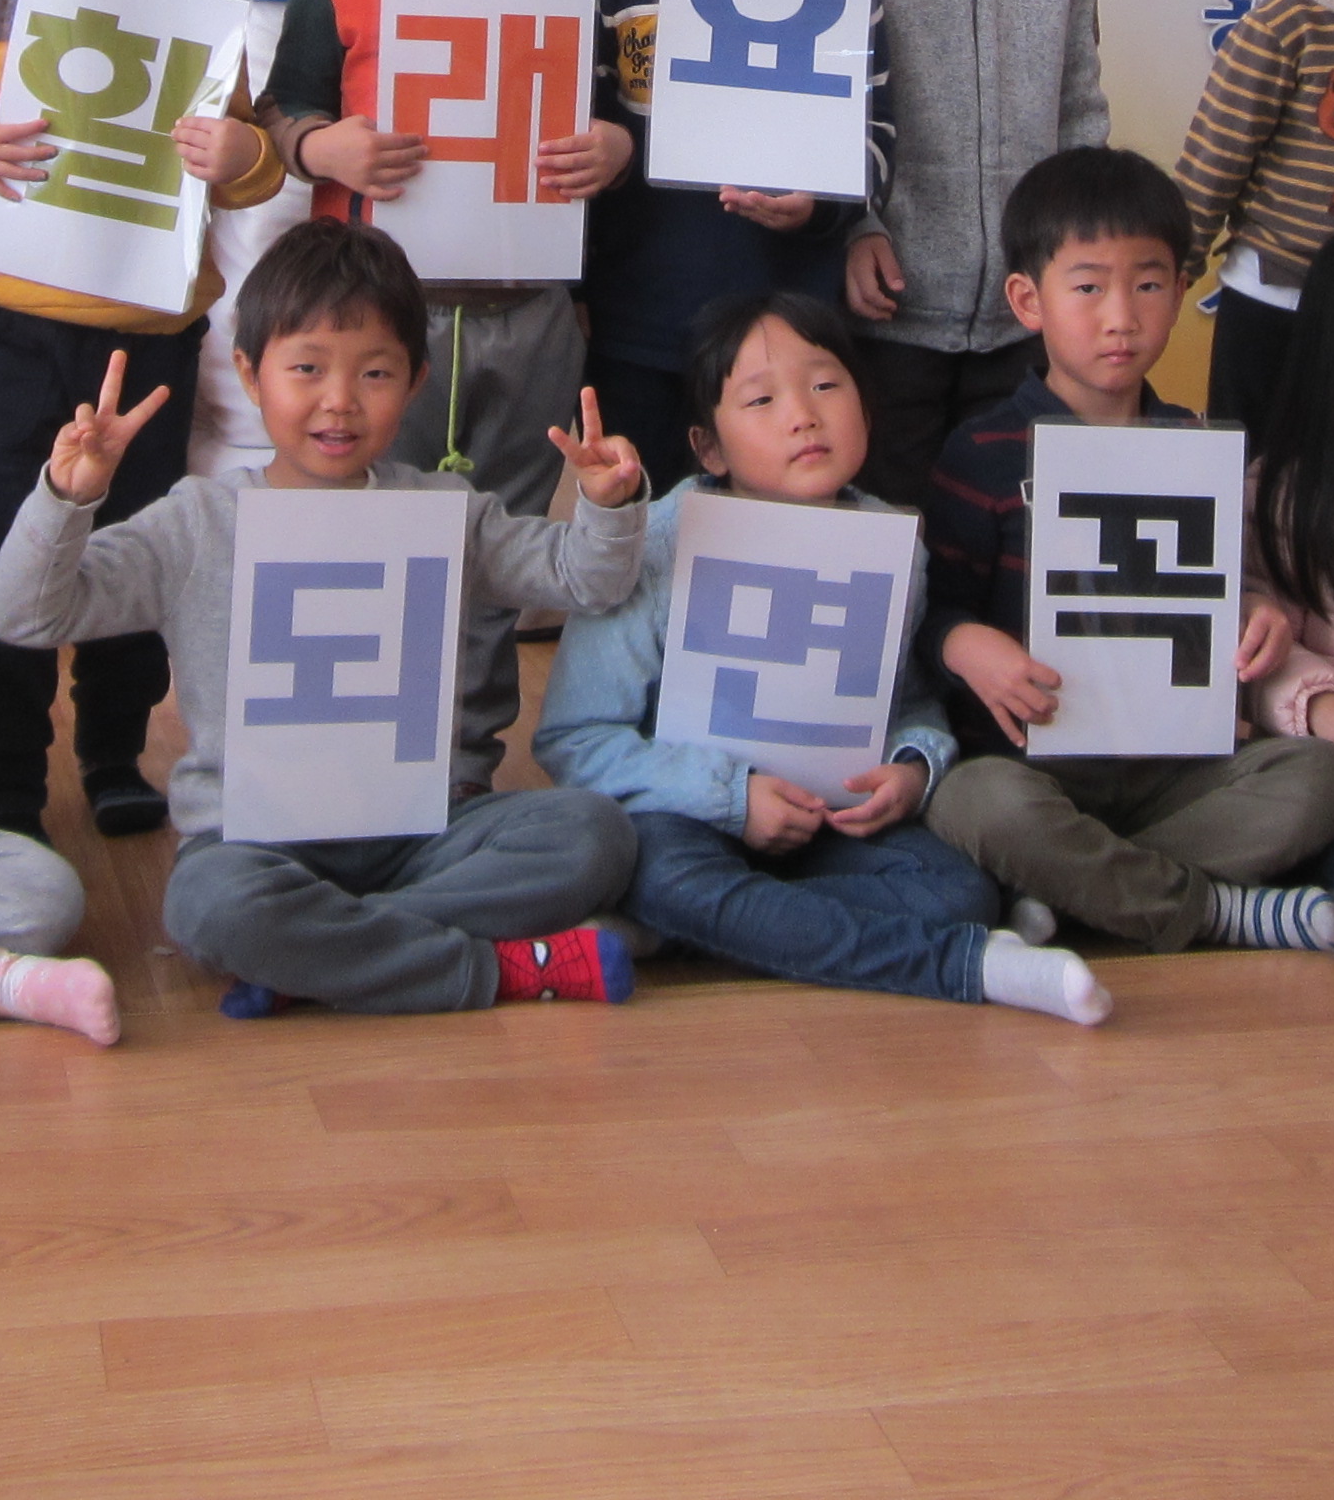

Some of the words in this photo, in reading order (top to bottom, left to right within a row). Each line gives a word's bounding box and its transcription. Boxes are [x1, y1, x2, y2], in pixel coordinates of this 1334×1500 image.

[17, 6, 223, 232] 할
[392, 13, 580, 205] 래
[243, 556, 449, 763] 되
[682, 555, 895, 748] 면
[1045, 491, 1227, 688] 꼭
